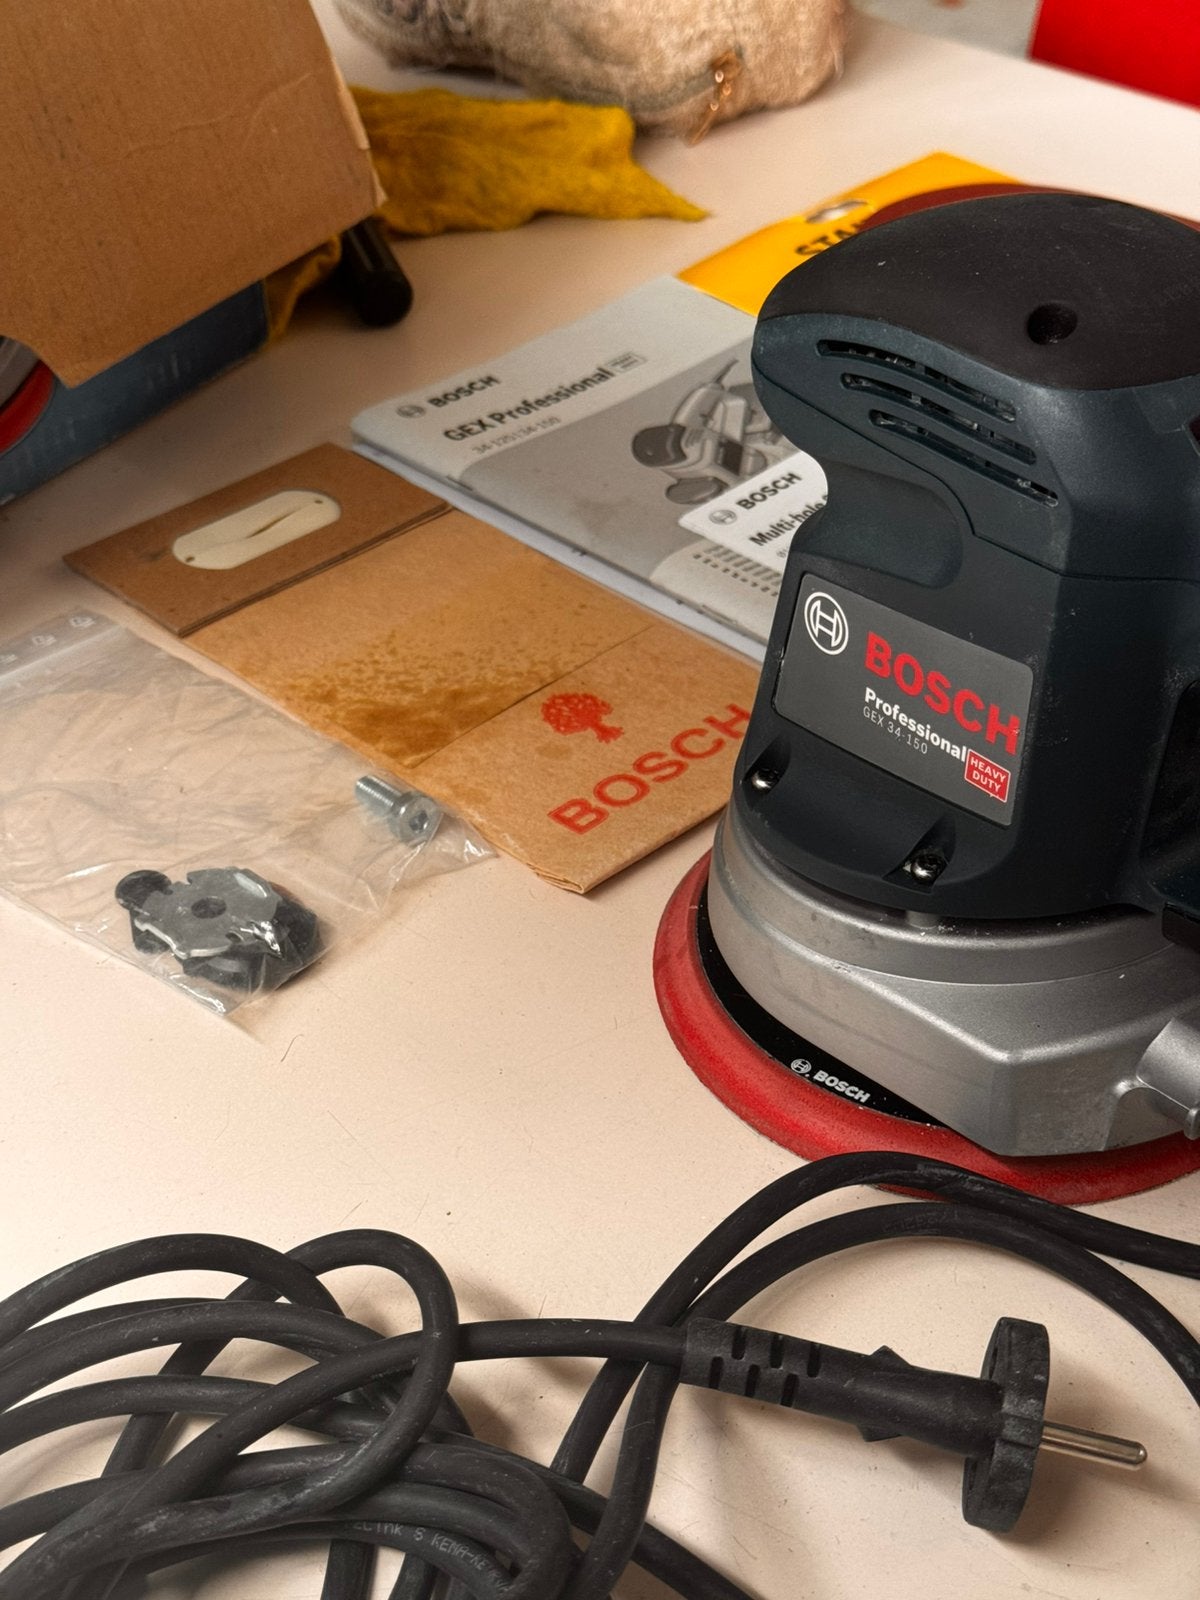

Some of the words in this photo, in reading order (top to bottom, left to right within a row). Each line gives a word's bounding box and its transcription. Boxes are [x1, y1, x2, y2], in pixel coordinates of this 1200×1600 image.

[427, 374, 502, 409] BOSCH
[443, 418, 497, 442] GEX
[487, 366, 616, 425] Professional
[736, 472, 803, 510] BOSCH
[865, 630, 1021, 756] BOSCH
[863, 706, 885, 728] GEX
[887, 720, 928, 755] 34-150
[864, 686, 967, 763] Professional
[547, 703, 751, 835] BOSCH
[970, 756, 1007, 783] HEAVY
[971, 769, 1002, 793] DUTY
[813, 1069, 871, 1103] BOSCH
